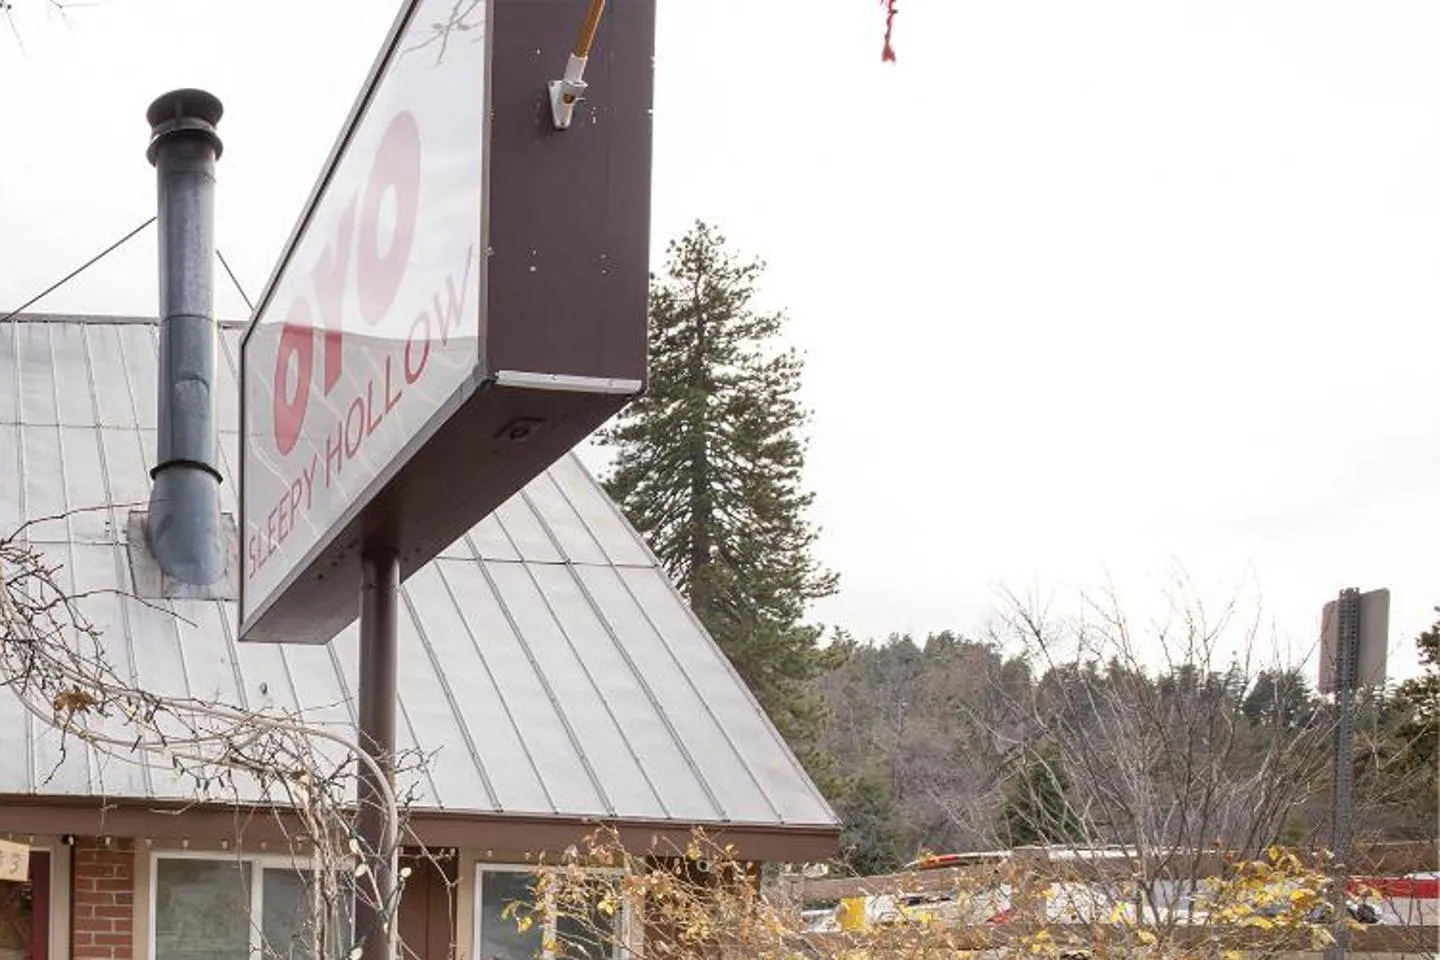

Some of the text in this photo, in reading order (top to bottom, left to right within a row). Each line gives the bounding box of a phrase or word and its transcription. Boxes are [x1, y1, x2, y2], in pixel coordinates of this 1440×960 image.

[248, 244, 474, 581] SLEEPY HOLLOW
[272, 109, 422, 457] OYO
